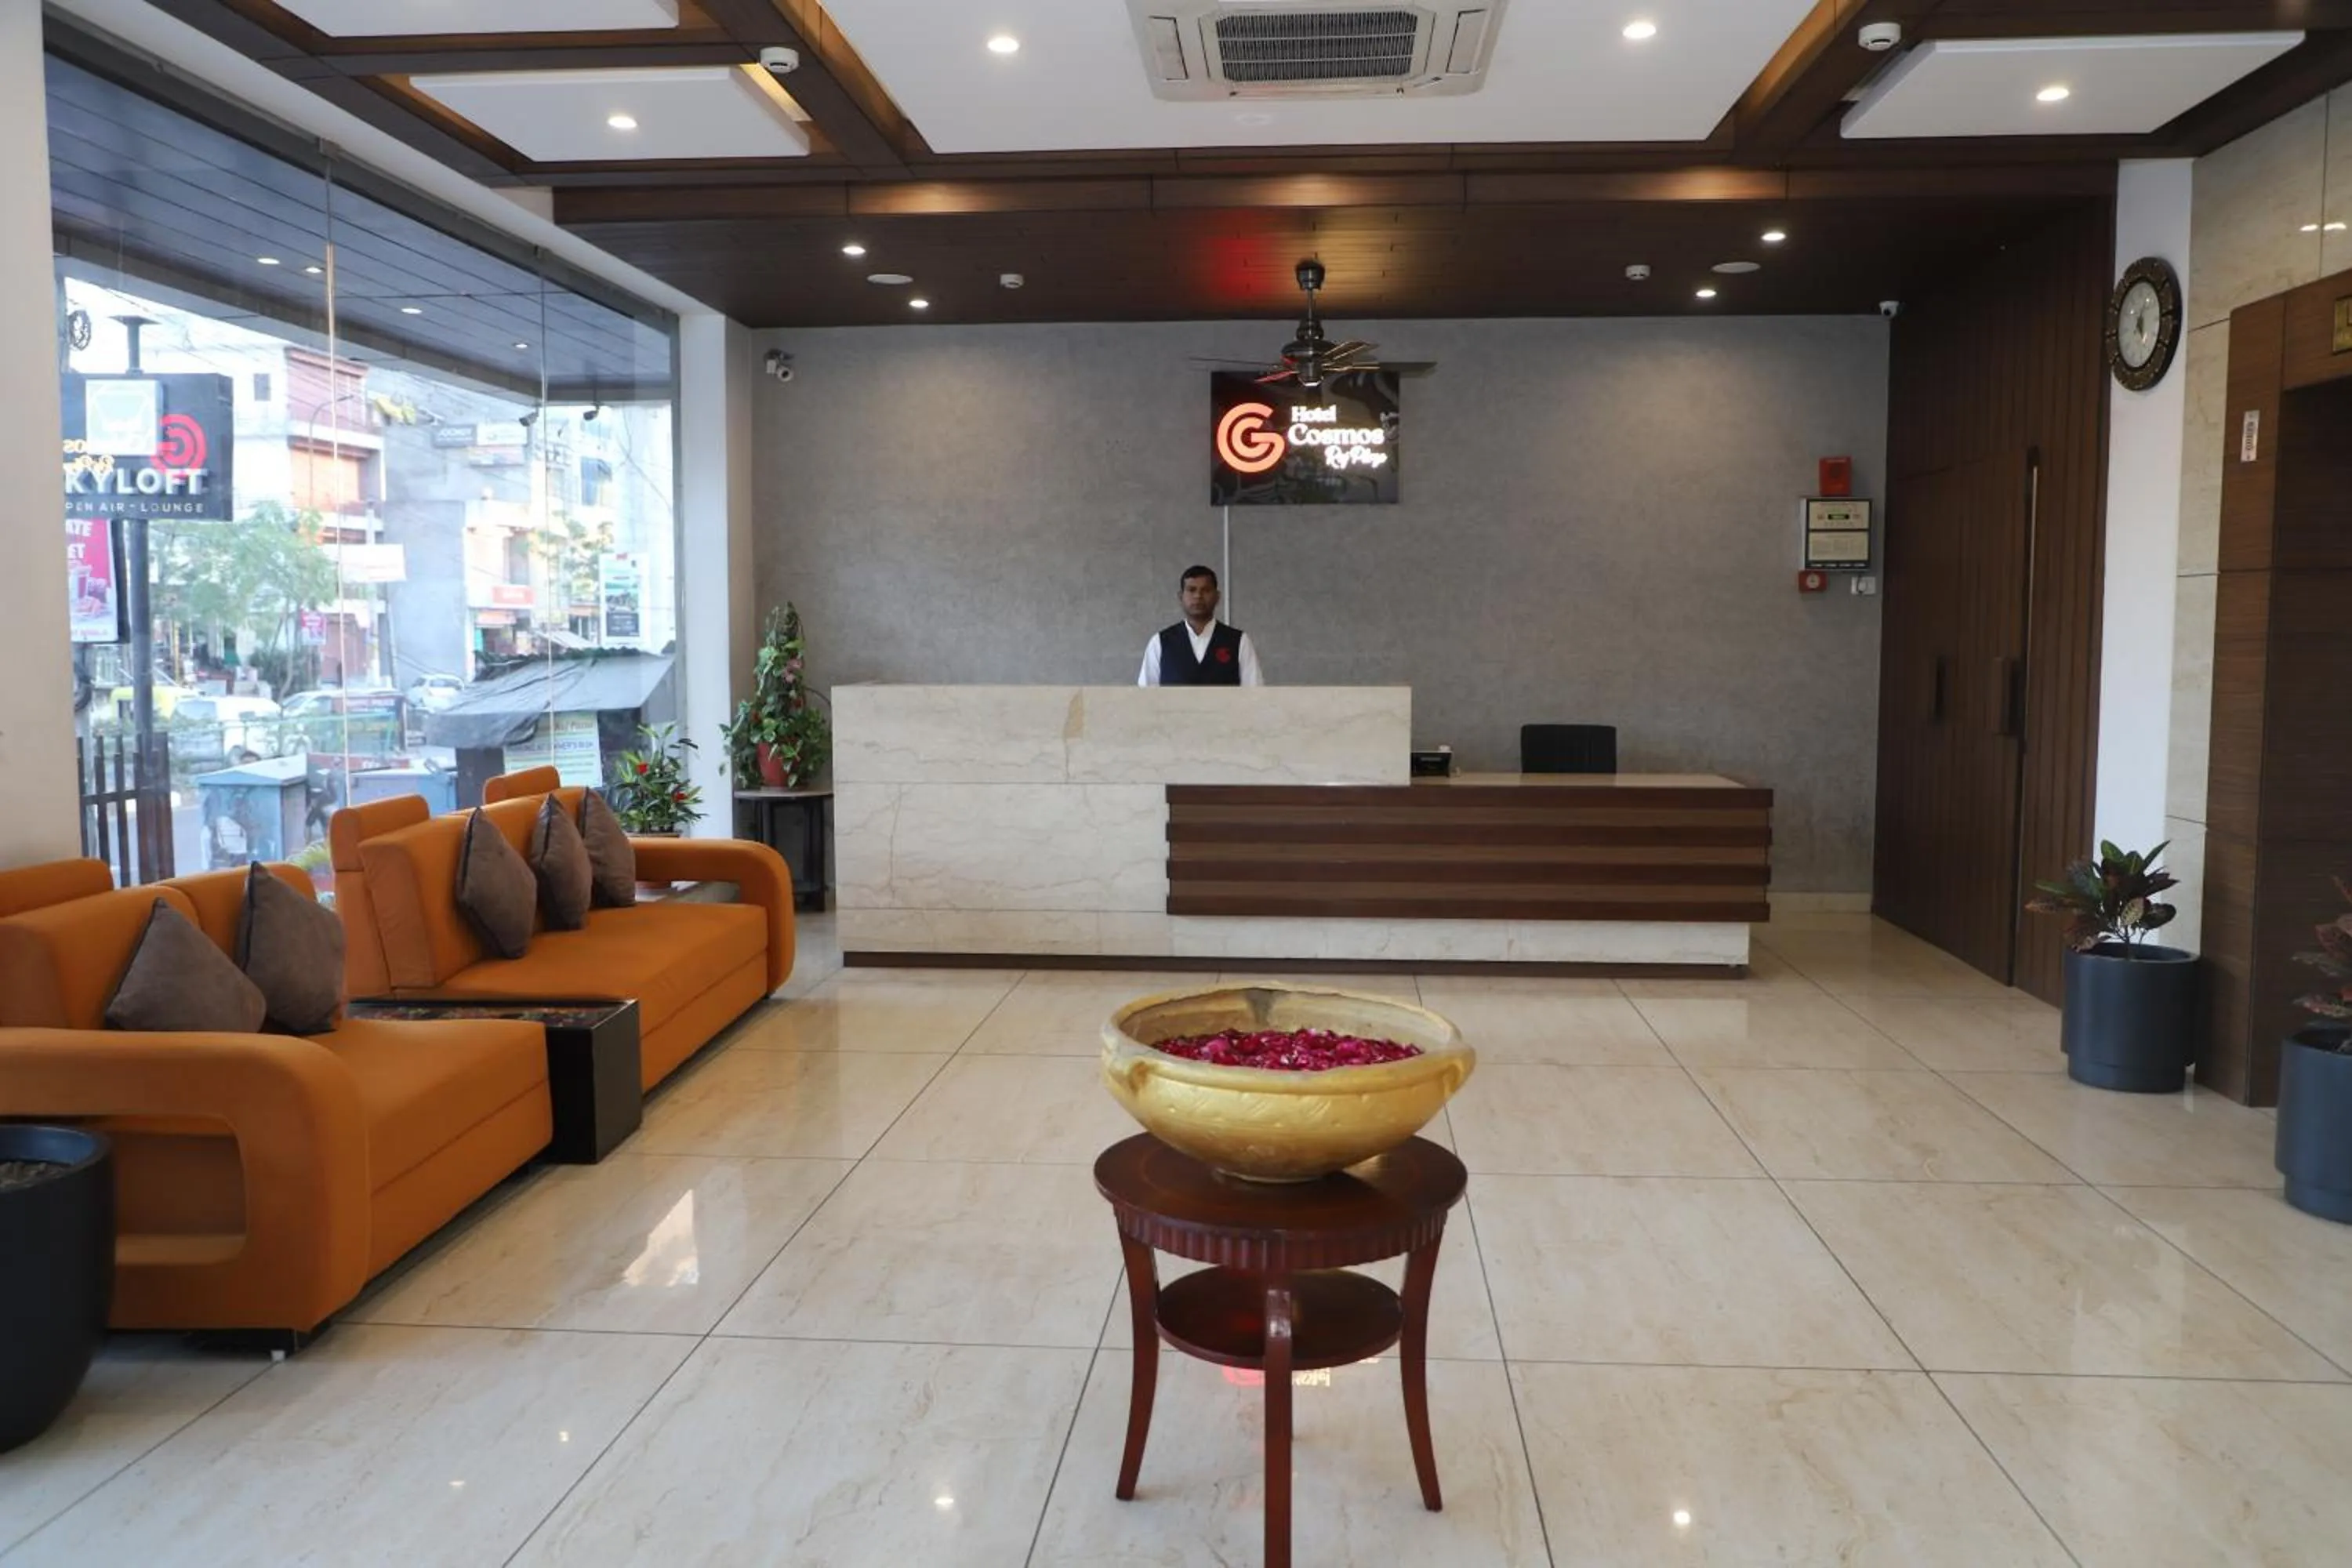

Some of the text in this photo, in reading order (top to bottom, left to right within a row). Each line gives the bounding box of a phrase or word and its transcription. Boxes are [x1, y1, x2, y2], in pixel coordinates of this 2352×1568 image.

[1291, 405, 1336, 422] Hotel
[1288, 423, 1385, 445] Cosmos
[66, 466, 208, 495] KYLOFT
[65, 501, 93, 512] PEN
[99, 502, 125, 513] AIR
[140, 502, 204, 514] LOUNGE
